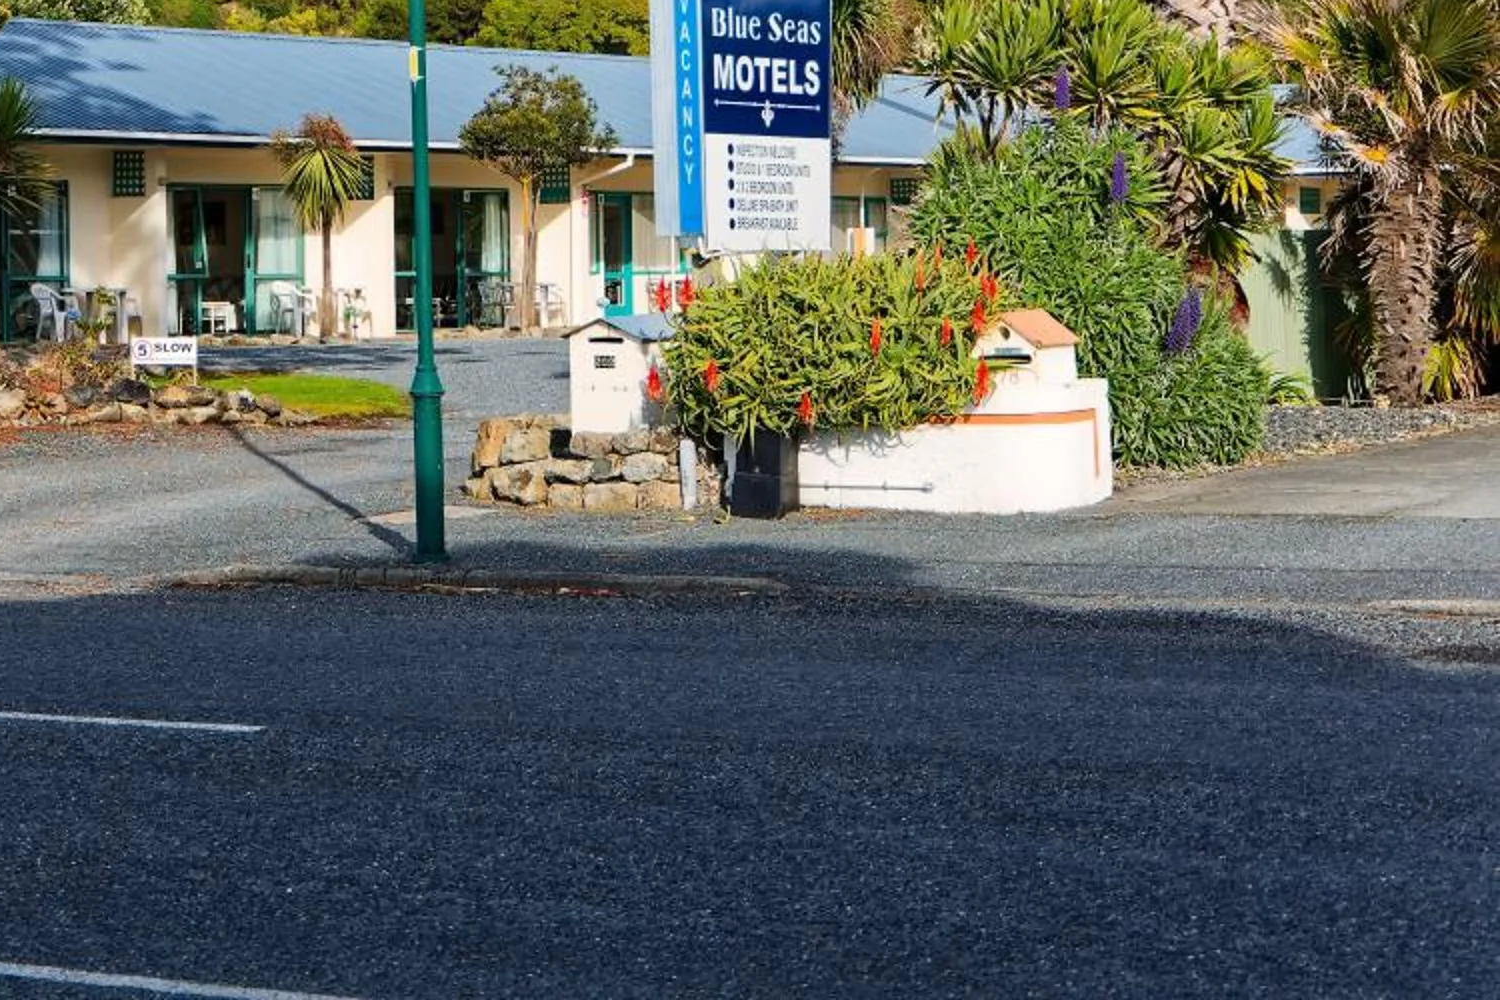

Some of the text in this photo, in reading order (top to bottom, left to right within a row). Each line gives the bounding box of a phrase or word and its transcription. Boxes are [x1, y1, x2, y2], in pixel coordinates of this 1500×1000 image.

[711, 6, 821, 45] Blue Seas
[713, 53, 821, 96] MOTELS
[153, 343, 193, 353] SLOW
